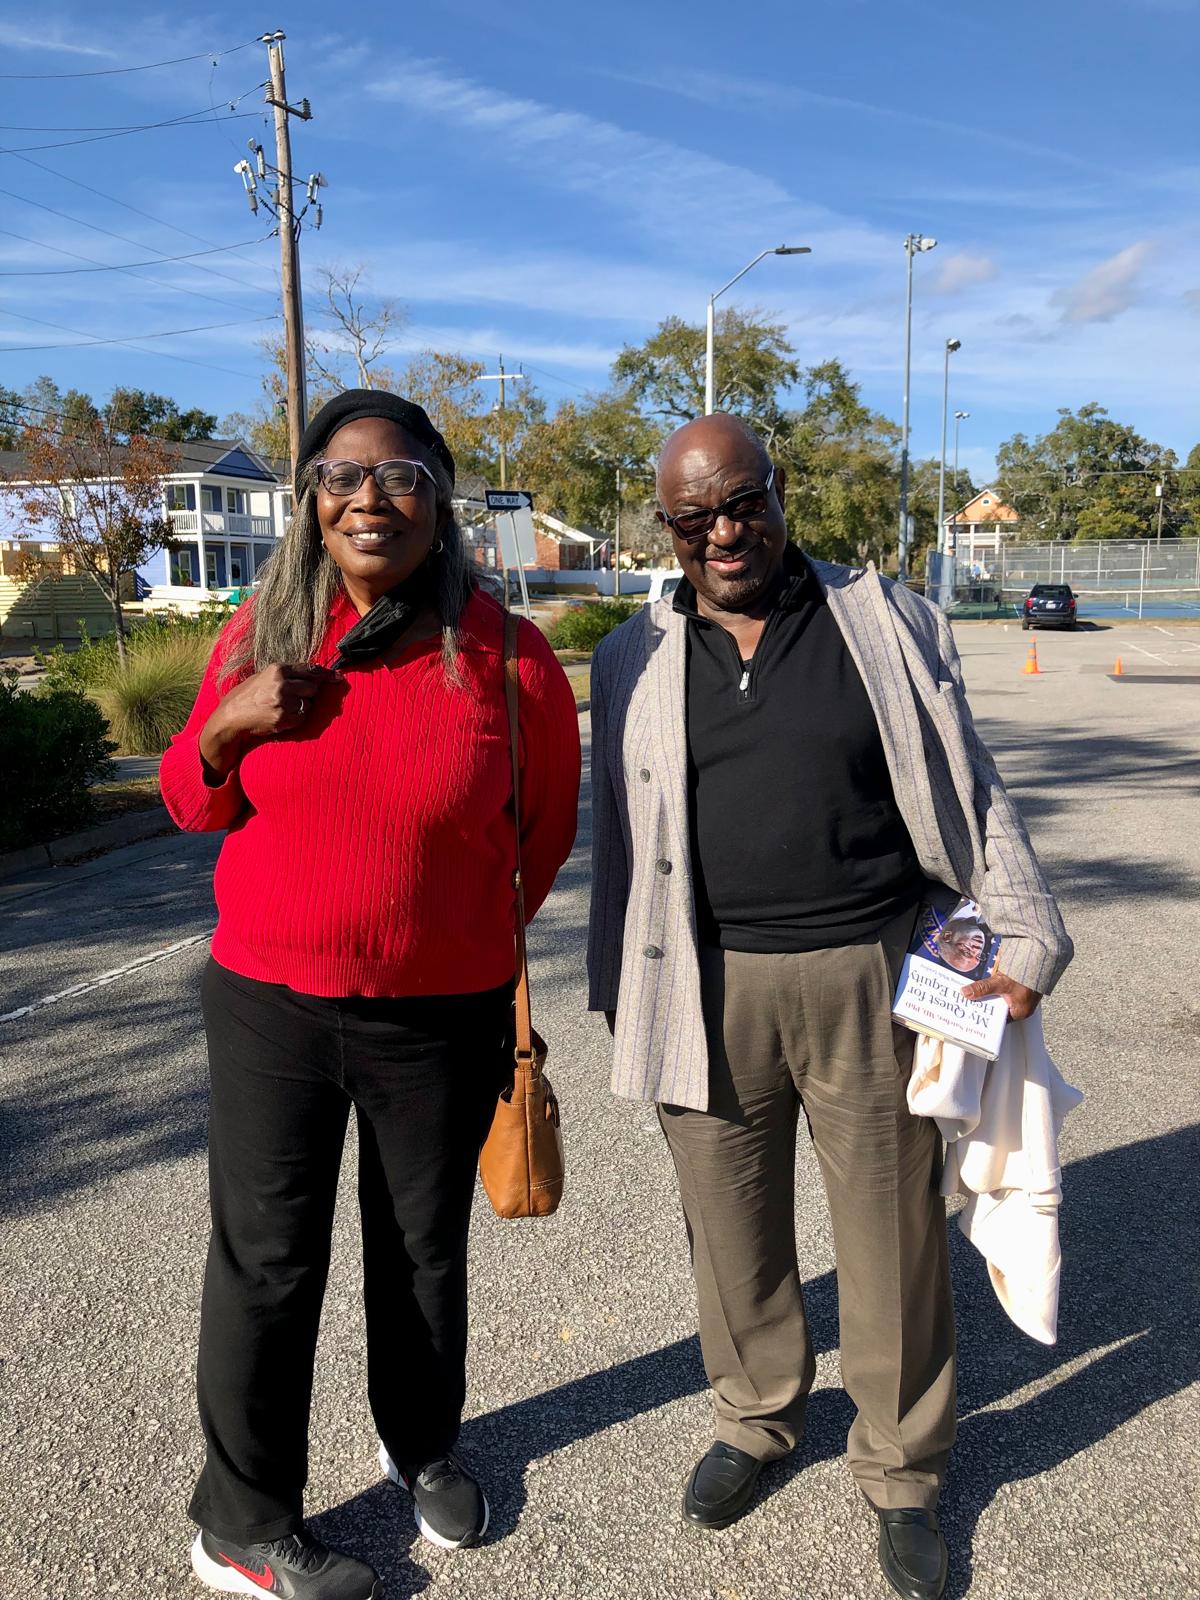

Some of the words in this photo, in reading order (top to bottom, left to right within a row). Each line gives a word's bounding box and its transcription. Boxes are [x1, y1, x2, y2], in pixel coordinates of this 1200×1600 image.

[490, 495, 505, 504] ONE
[506, 496, 519, 504] WAY
[910, 970, 949, 997] Equity
[907, 986, 926, 1003] for
[905, 1002, 921, 1012] PhD
[929, 995, 965, 1019] Quest
[968, 1011, 990, 1028] My
[966, 1027, 986, 1040] David
